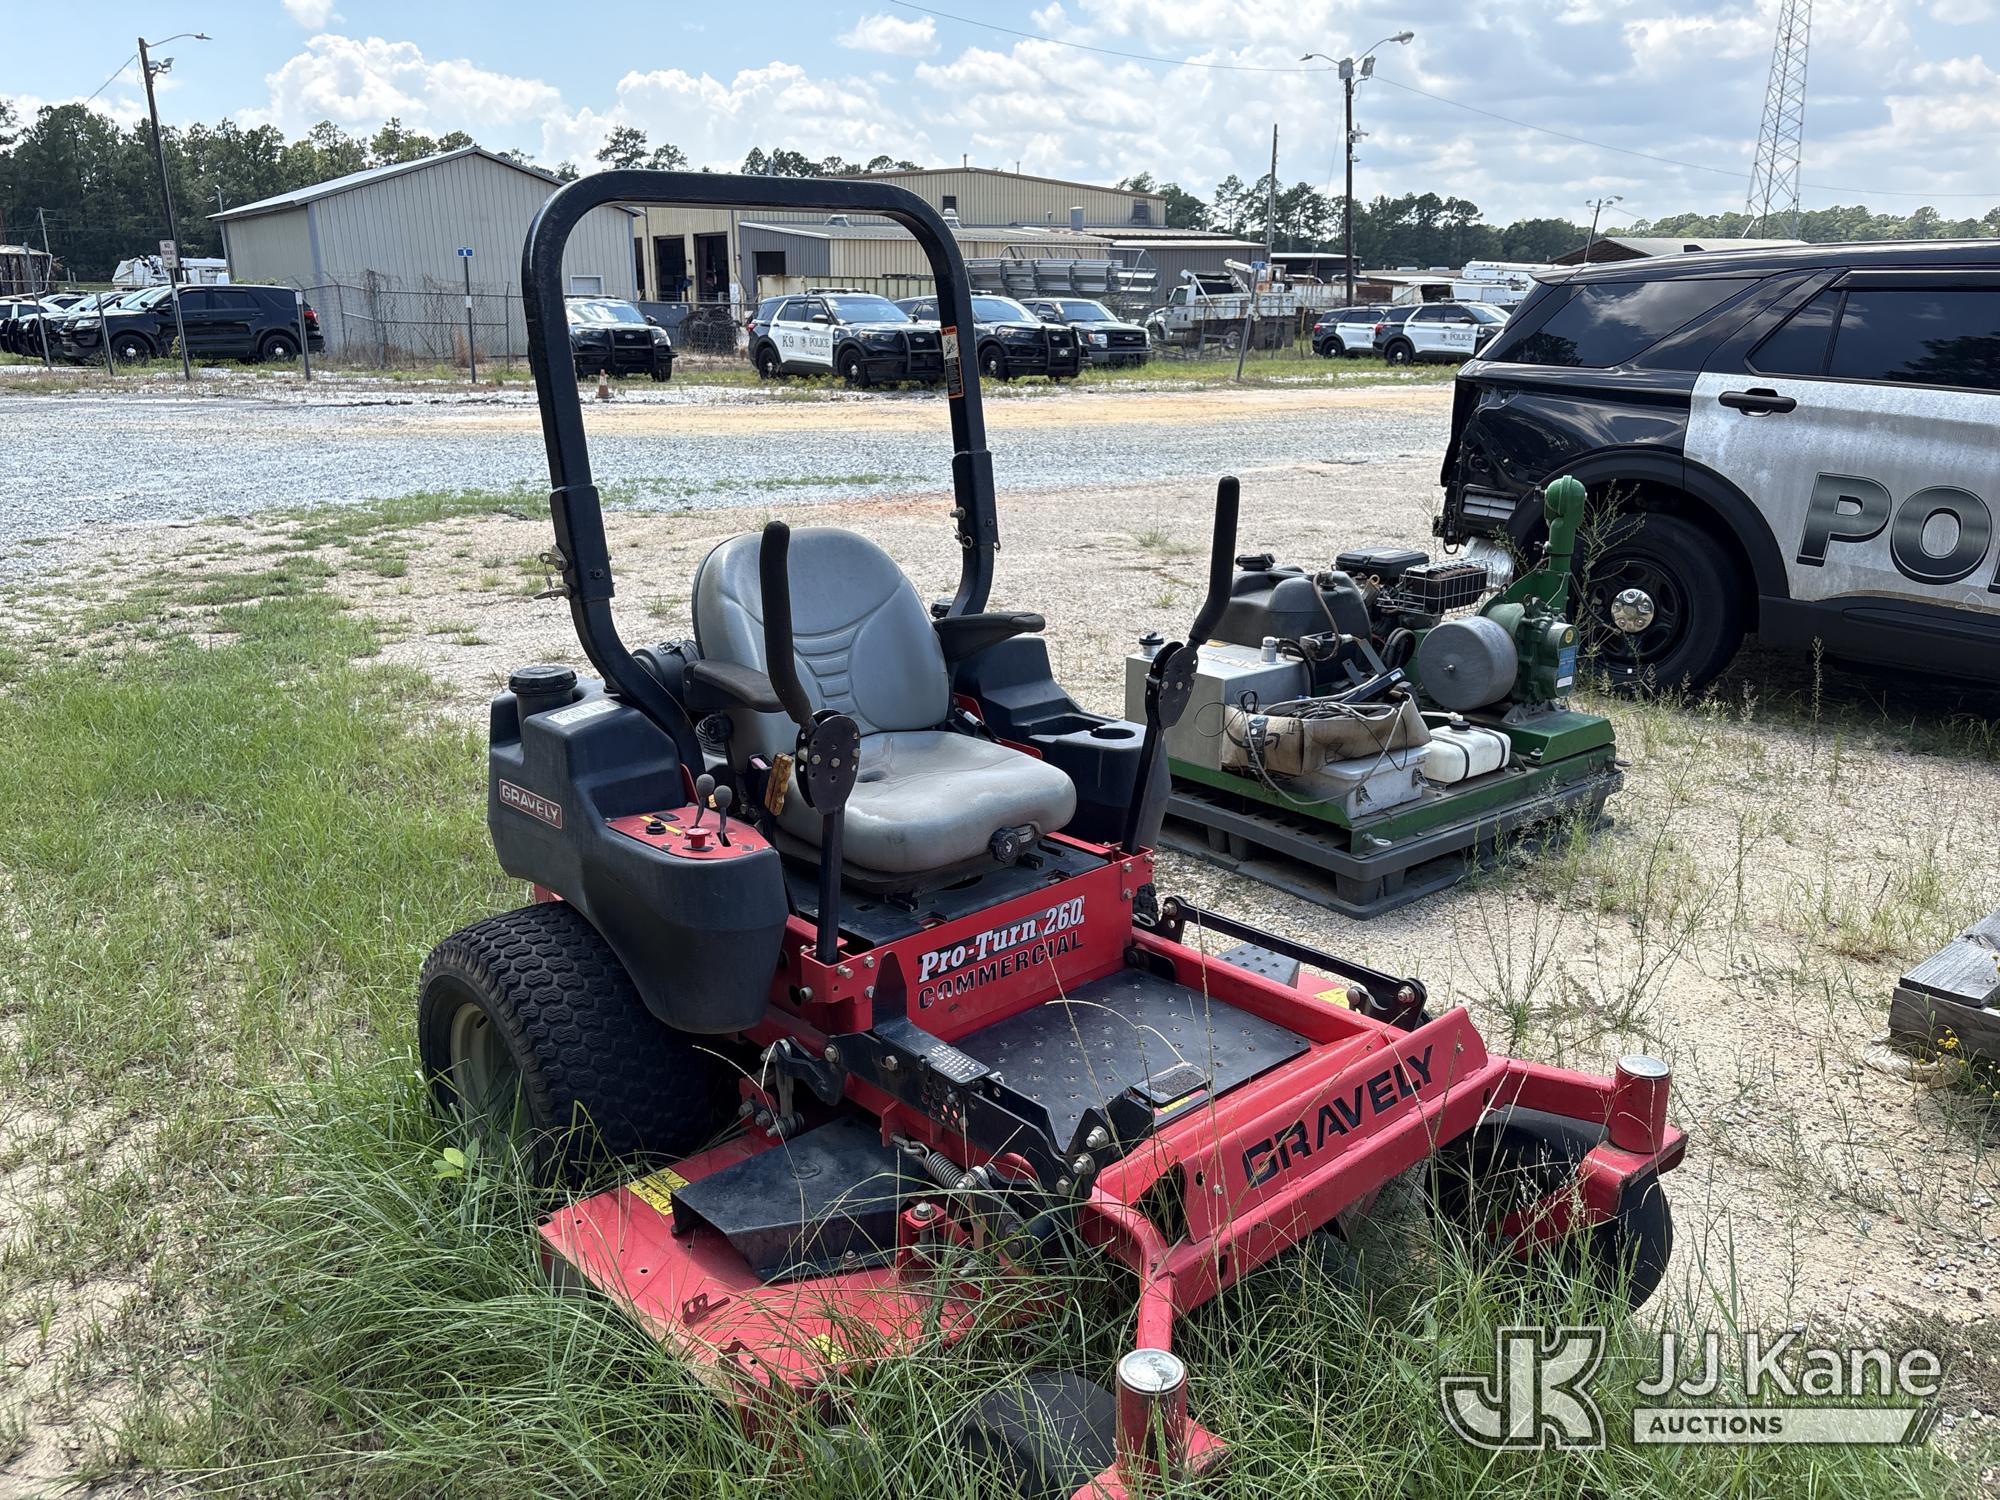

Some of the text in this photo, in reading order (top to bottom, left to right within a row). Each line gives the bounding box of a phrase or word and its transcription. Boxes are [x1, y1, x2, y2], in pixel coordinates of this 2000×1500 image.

[782, 335, 795, 348] K9
[808, 336, 831, 349] POLICE
[1450, 333, 1473, 341] POLICE
[501, 784, 559, 821] GRAVELY
[918, 896, 1085, 984] Pro-Turn 260
[917, 930, 1084, 1010] COMMERCIAL
[1241, 1044, 1434, 1189] GRAVELY
